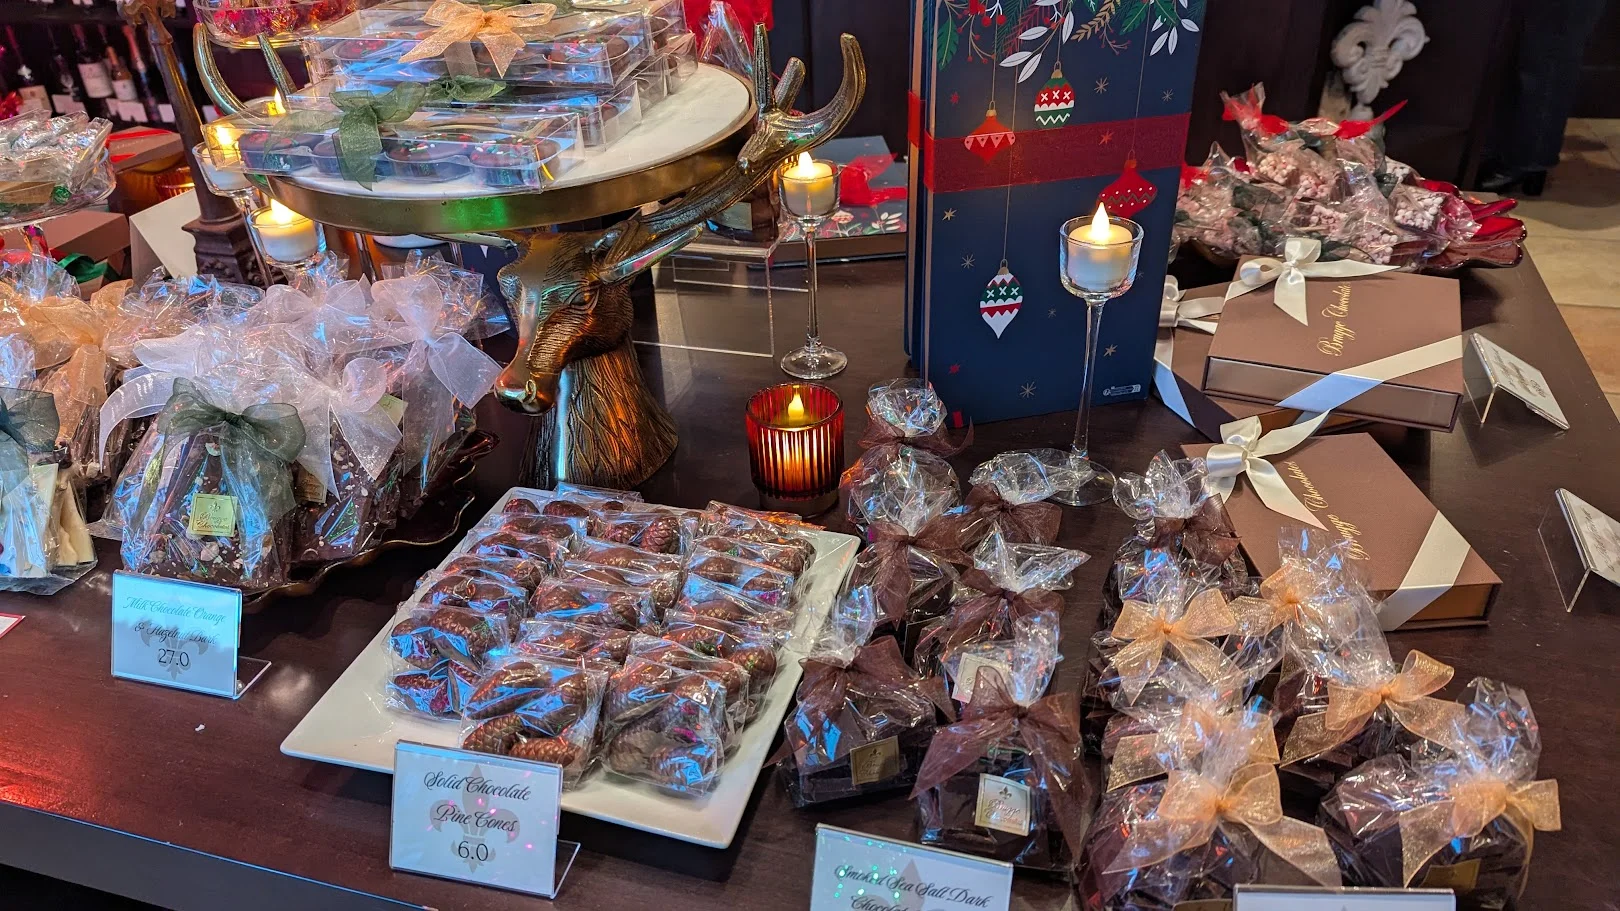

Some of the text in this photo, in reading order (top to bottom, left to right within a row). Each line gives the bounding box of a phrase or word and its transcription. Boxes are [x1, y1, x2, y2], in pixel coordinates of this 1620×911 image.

[123, 596, 227, 626] Milk Chocolate Orange
[134, 621, 219, 645] & Hazelnut Bark
[158, 648, 190, 667] 27.0
[424, 771, 532, 801] Solid Chocolate
[433, 803, 518, 832] Pine Cones
[458, 840, 489, 862] 6.0
[886, 876, 915, 893] Sea
[915, 882, 950, 899] Salt
[946, 887, 994, 908] Dark
